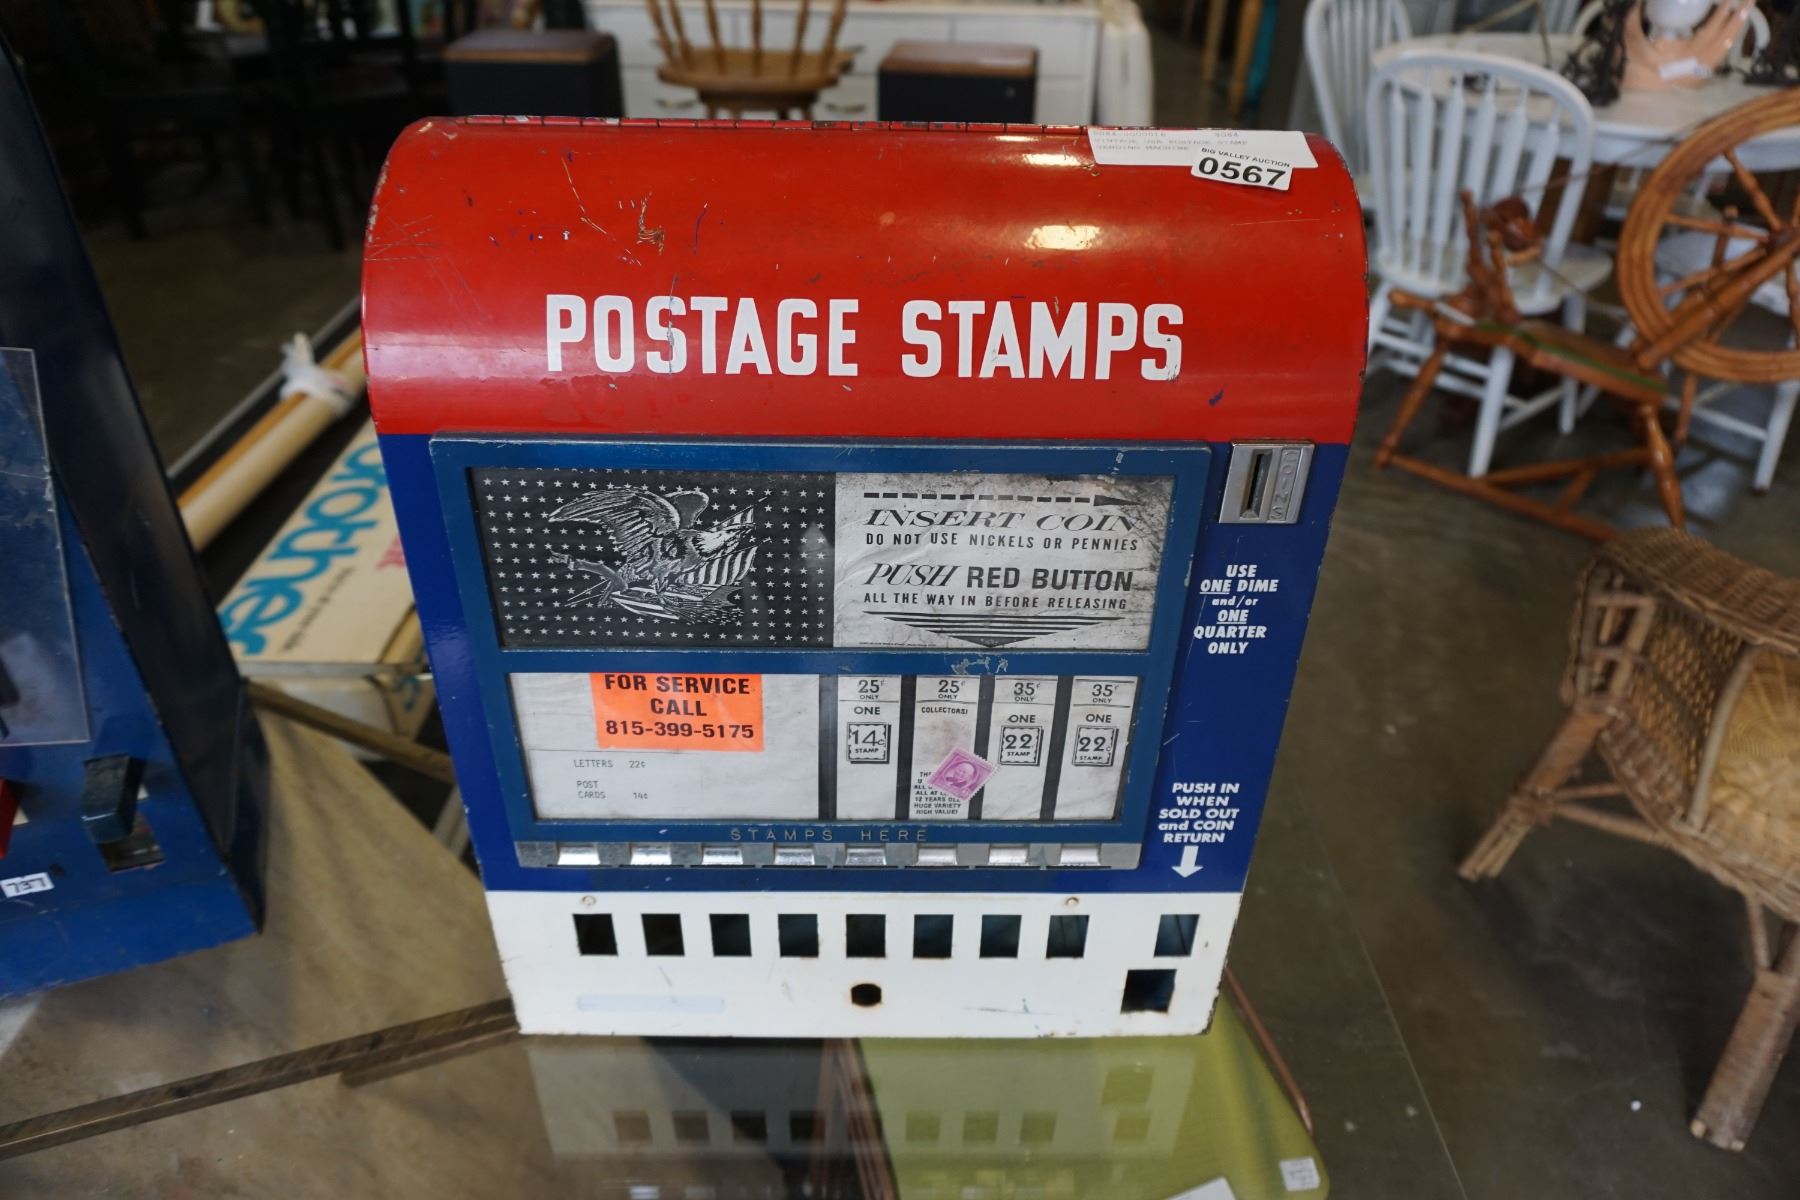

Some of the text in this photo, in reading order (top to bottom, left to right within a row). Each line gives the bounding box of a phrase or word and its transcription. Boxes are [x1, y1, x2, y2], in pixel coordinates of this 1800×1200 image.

[1218, 151, 1251, 160] VALLEY
[1252, 157, 1290, 167] AUCTION
[1198, 157, 1286, 186] 0567
[546, 294, 1183, 381] POSTAGE STAMPS
[863, 509, 1143, 532] INSERT COIN
[866, 533, 1139, 551] DO NOT USE NICKELS OR PENNIES
[863, 563, 1134, 592] PUSH RED BUTTON
[1226, 564, 1257, 578] USE
[1200, 579, 1279, 593] ONE DIME
[863, 592, 1128, 610] ALL THE WAY IN BEFORE RELEASING
[1217, 609, 1249, 623] ONE
[1193, 625, 1267, 639] QUARTER
[1207, 641, 1249, 655] ONLY
[604, 674, 751, 695] FOR SERVICE
[650, 698, 708, 717] CALL
[854, 706, 881, 715] ONE
[1009, 714, 1036, 723] ONE
[1086, 713, 1112, 723] ONE
[606, 720, 755, 739] 815-399-5175
[573, 759, 614, 768] LETTERS
[576, 780, 599, 789] POST
[1171, 782, 1240, 794] PUSH IN
[577, 790, 607, 799] CARDS
[1176, 796, 1230, 807] WHEN
[1158, 808, 1240, 819] SOLD OUT
[1158, 820, 1235, 831] and COIN
[730, 828, 927, 841] STAMPS HERE
[1163, 832, 1226, 843] RETURN
